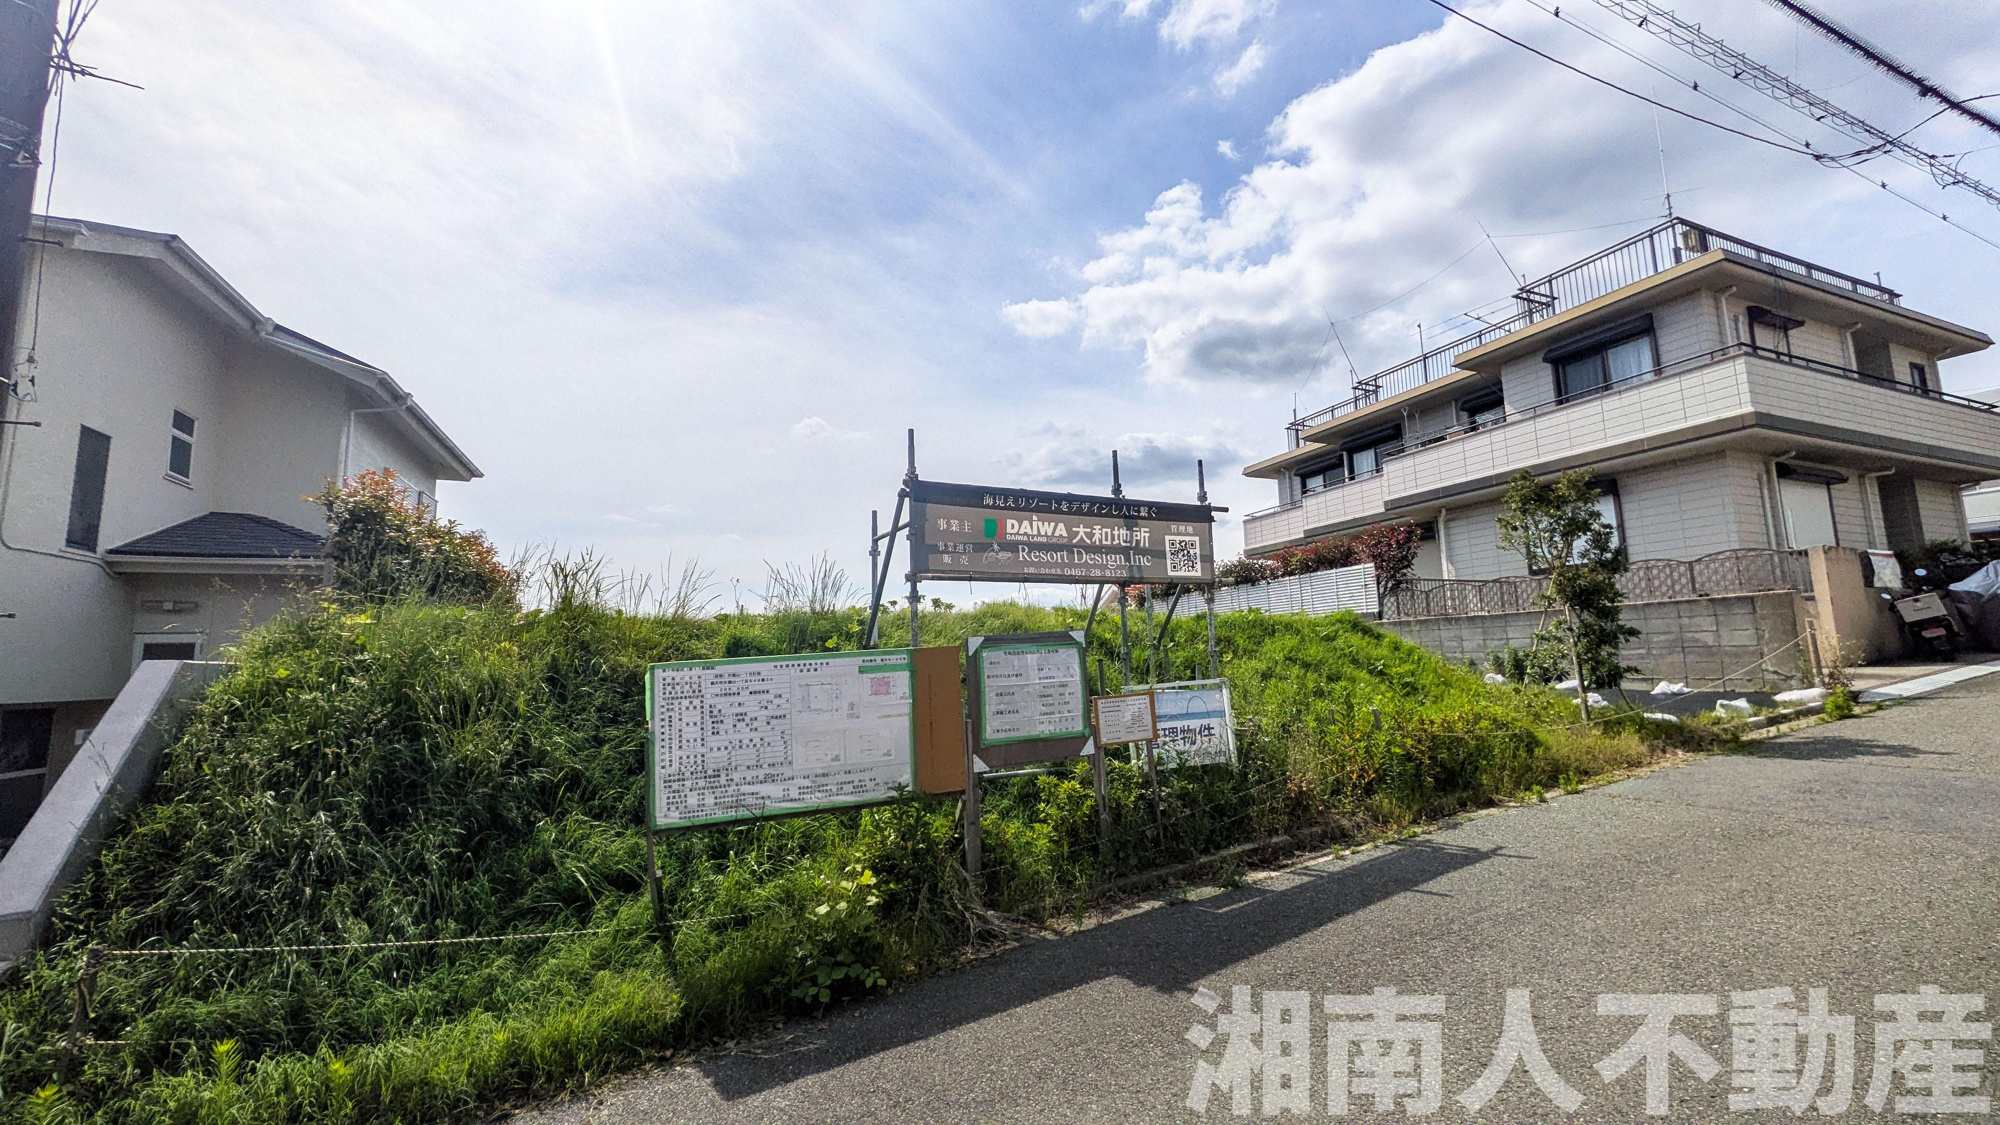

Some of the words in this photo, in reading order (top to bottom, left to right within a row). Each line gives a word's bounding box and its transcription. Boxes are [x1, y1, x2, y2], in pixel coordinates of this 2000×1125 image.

[983, 493, 1158, 517] 海見えリゾートをデザインし人に繋ぐ
[938, 518, 972, 533] 事業主
[1170, 525, 1194, 534] 管理地
[1072, 524, 1150, 547] 大和地所
[937, 542, 974, 553] 事業運営
[1018, 544, 1069, 563] Resort
[1064, 568, 1127, 577] 0467-28-8123
[1152, 723, 1215, 750] 理物件
